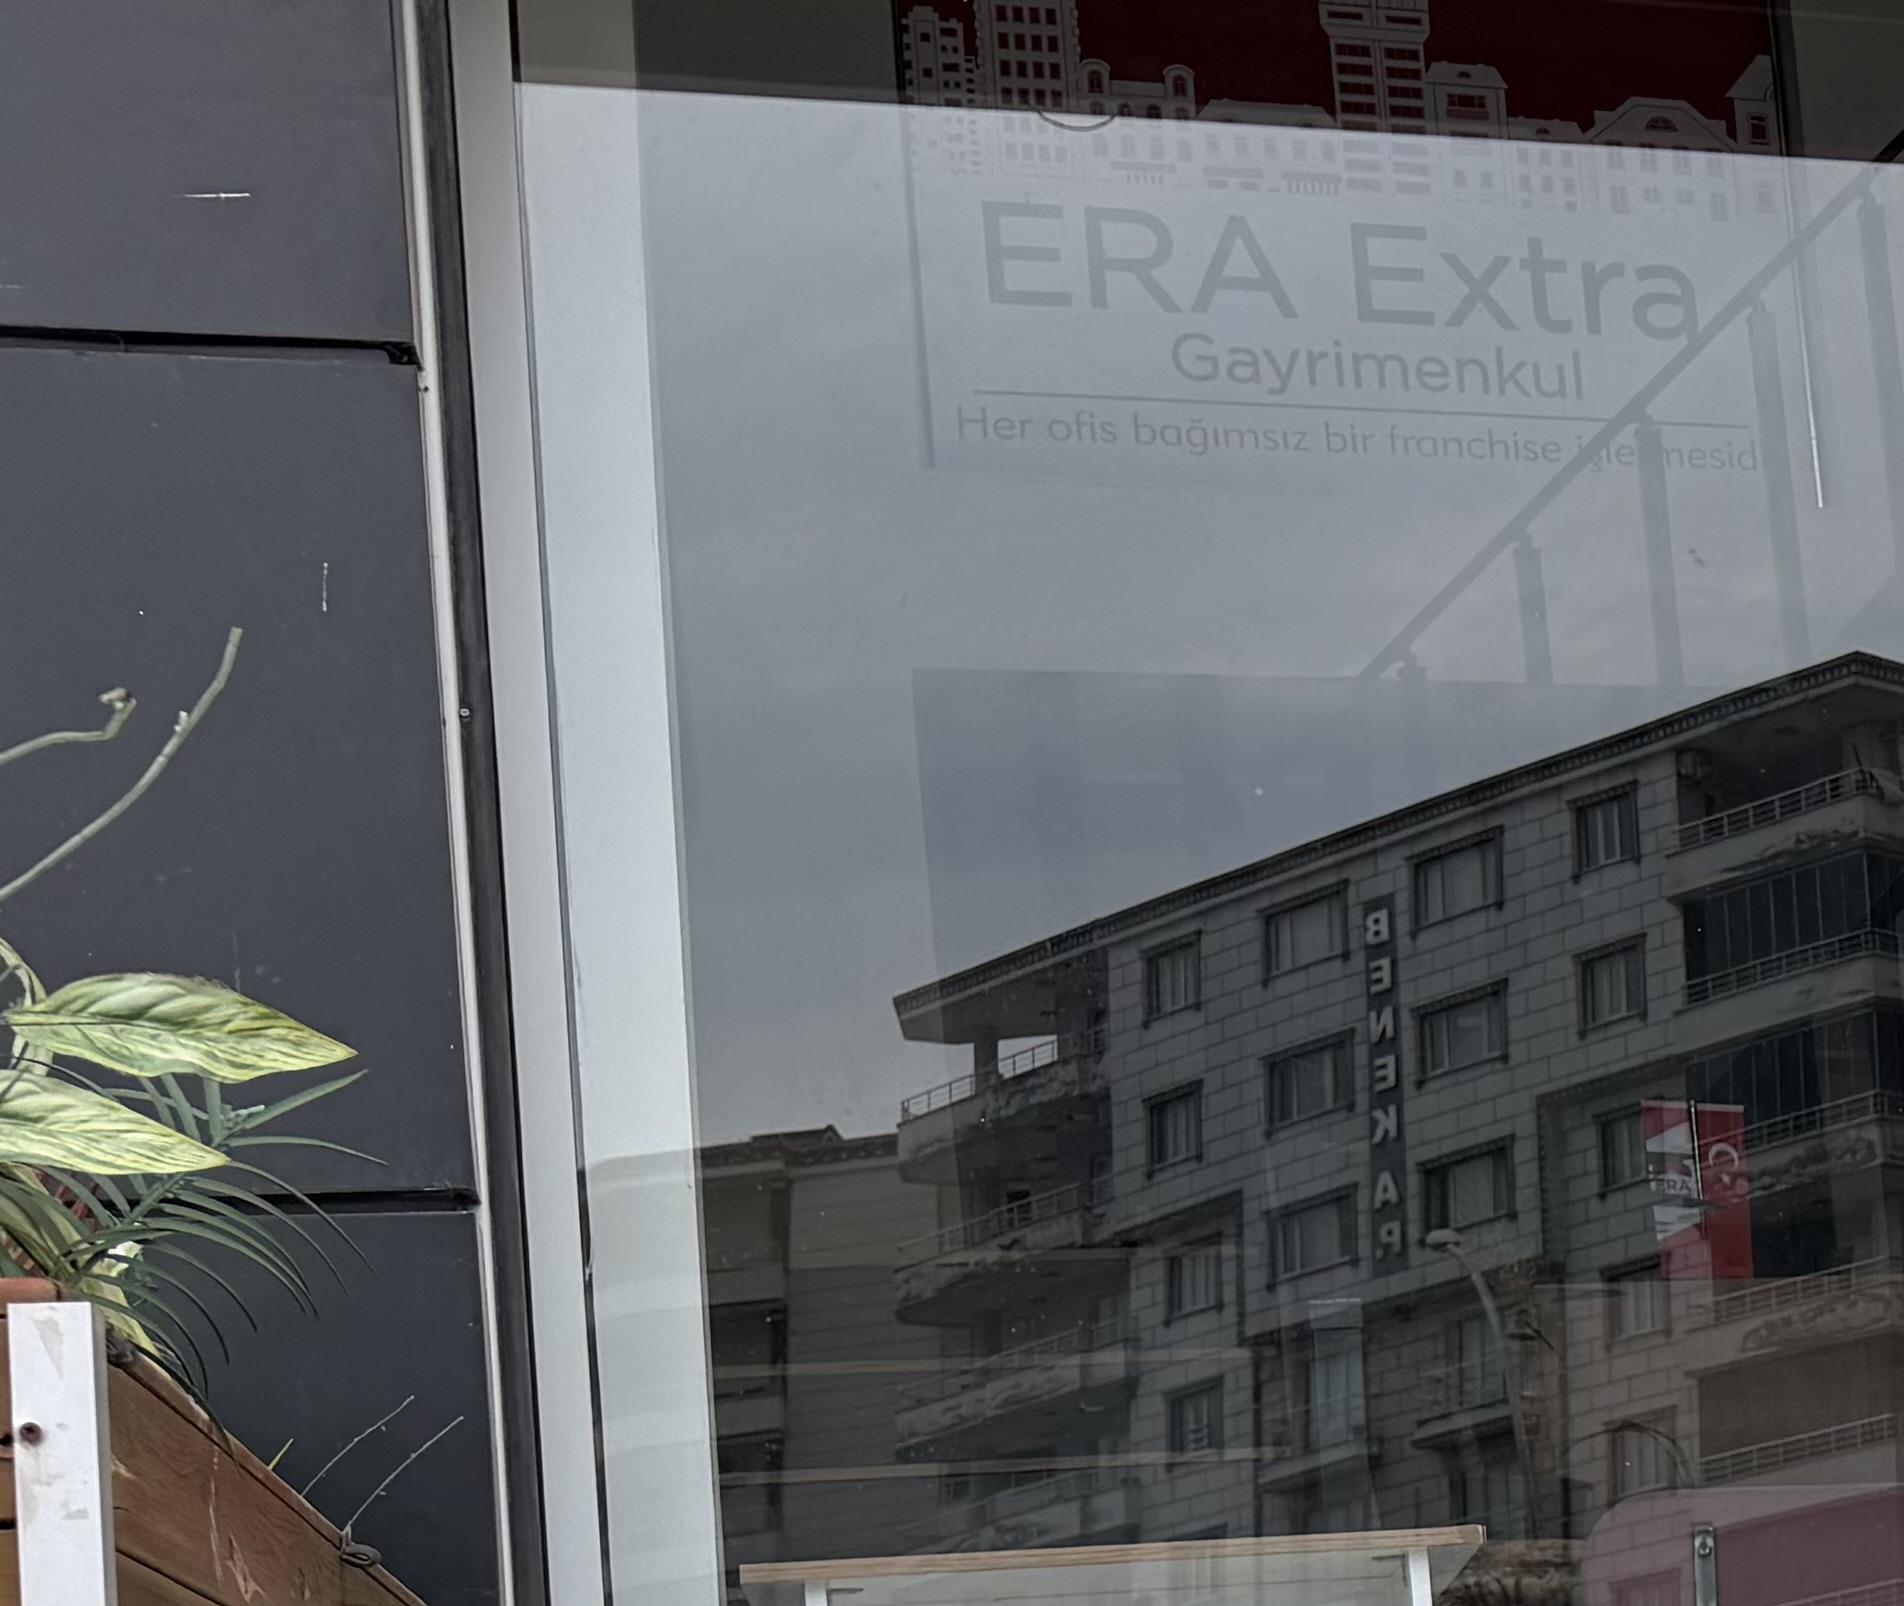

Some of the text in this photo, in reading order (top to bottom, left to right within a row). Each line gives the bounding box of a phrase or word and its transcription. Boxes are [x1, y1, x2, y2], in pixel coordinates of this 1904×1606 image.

[981, 200, 1700, 343] ERA Extra
[1170, 331, 1583, 400] Gayrimenkul
[956, 405, 1033, 442] Her
[1047, 409, 1118, 443] ofis
[1133, 412, 1312, 455] bağımsız
[1324, 421, 1374, 455] bir
[1389, 423, 1563, 463] franchise
